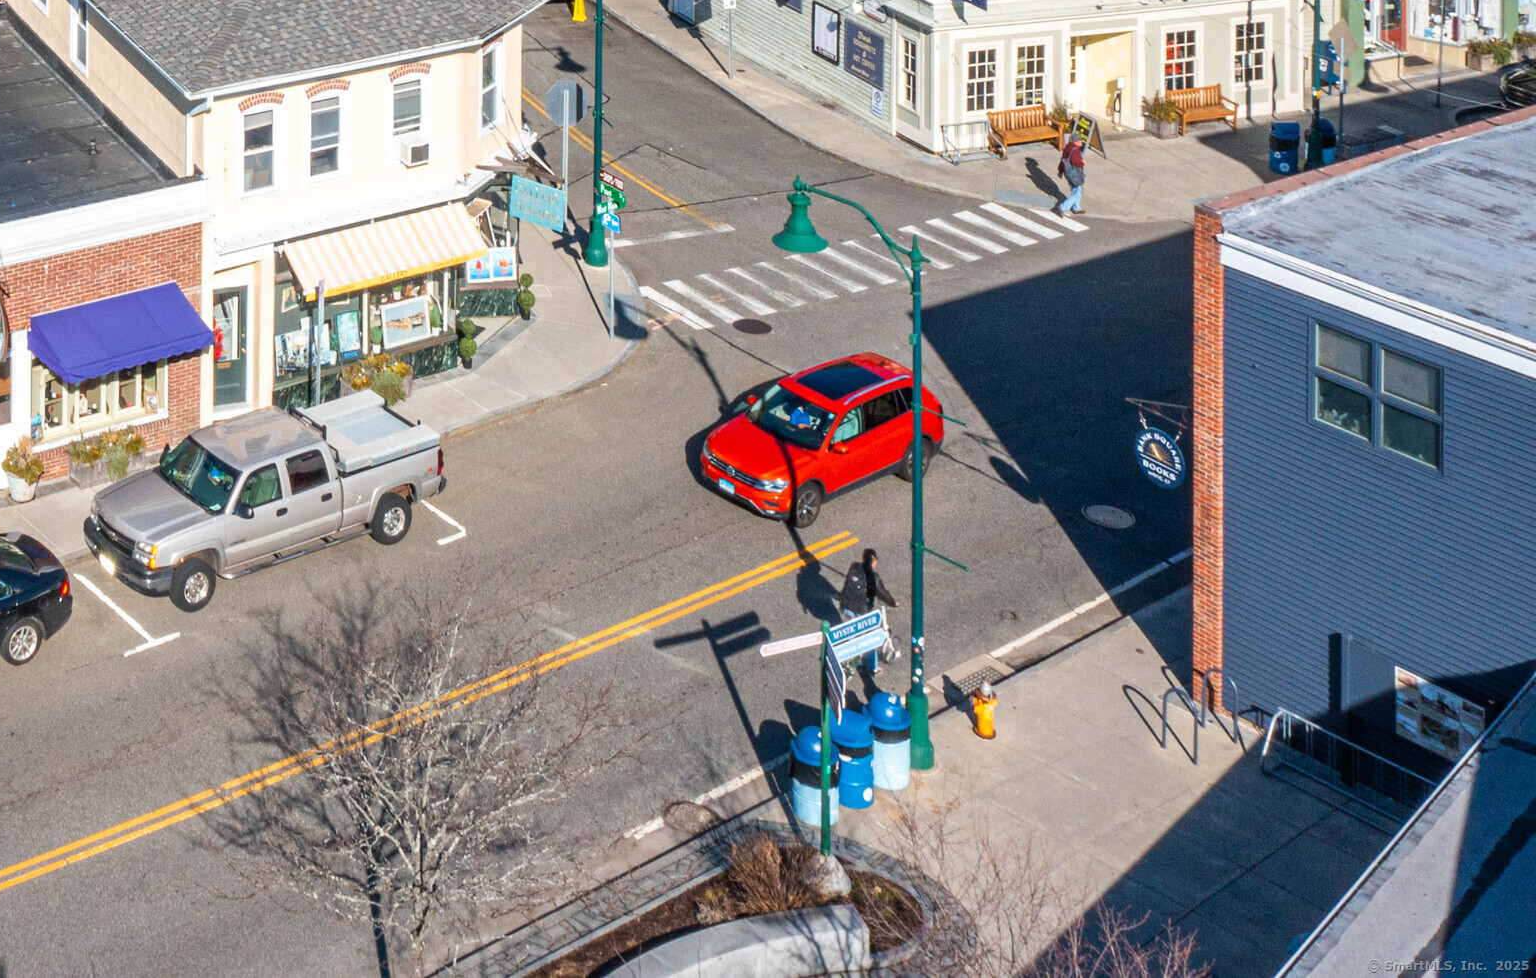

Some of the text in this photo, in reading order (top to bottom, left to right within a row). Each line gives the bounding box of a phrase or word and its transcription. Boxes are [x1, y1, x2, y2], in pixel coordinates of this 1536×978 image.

[1137, 432, 1182, 471] BANK SQUARE
[1142, 459, 1176, 481] BOOKS
[832, 615, 877, 640] MYSTIC RIVER
